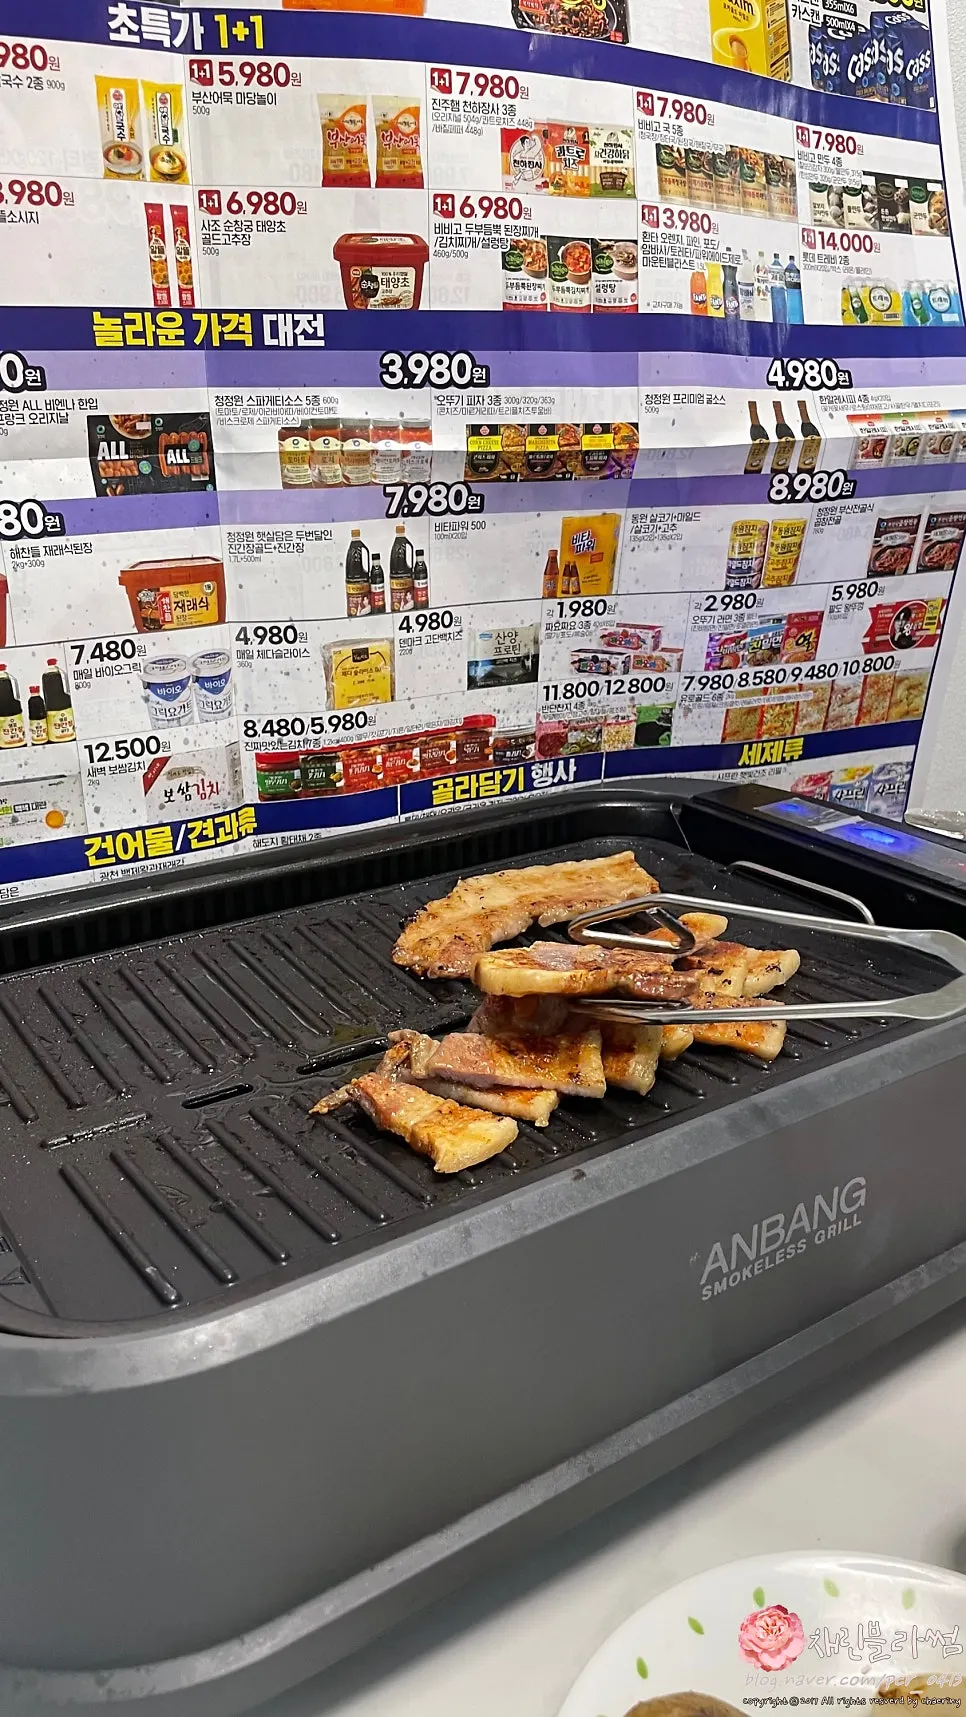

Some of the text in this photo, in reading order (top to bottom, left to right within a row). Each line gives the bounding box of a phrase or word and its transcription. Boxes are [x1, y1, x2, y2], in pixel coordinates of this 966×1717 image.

[792, 4, 820, 25] 카스캔
[108, 2, 264, 50] 초특가 1+1
[193, 62, 212, 80] 1+1
[26, 77, 66, 92] 2종 900g
[432, 71, 450, 87] 1+1
[192, 92, 277, 106] 부산어묵 마당놀이
[192, 106, 210, 116] 500g
[432, 99, 516, 116] 진주햄 천하장사 3종
[638, 119, 661, 132] 비비고
[662, 122, 671, 134] 국
[200, 191, 308, 216] 1+1 6,980원
[435, 195, 532, 220] 1+1 6,980원
[201, 220, 286, 234] 사조 순창궁 태양초
[434, 223, 539, 238] 비비고 두부듬뿍 된장찌개
[201, 233, 251, 247] 골드고추장
[642, 231, 658, 243] 환타
[203, 247, 220, 257] 500g
[433, 250, 469, 259] 460g/500g
[381, 277, 410, 289] 태양초
[92, 311, 325, 347] 놀라운 가격 대전
[22, 398, 98, 411] ALL 비엔나 한입
[215, 395, 339, 407] 청정원 스파게티소스 5종 600g
[436, 395, 465, 406] 오뚜기
[467, 395, 485, 406] 피자
[487, 395, 502, 406] 3종
[645, 394, 725, 405] 청정원 프리미엄 굴소스
[645, 406, 659, 414] 500g
[29, 412, 69, 425] 오리지날
[97, 441, 129, 461] ALL
[166, 449, 190, 464] ALL
[632, 513, 648, 524] 동원
[434, 520, 486, 532] 비타파워 500
[227, 530, 332, 543] 청정원 햇살담은 두번달인
[571, 530, 591, 545] 비타
[10, 542, 93, 559] 해찬들 재래식된장
[574, 539, 596, 555] 파워
[11, 559, 45, 569] 2kg+300g
[173, 597, 210, 612] 재래식
[578, 621, 591, 630] 3종
[692, 615, 715, 625] 오뚜기
[424, 631, 463, 646] 고단백치즈
[495, 630, 519, 645] 산양
[236, 649, 310, 660] 매일 체다슬라이스
[493, 644, 520, 656] 프로틴
[73, 662, 142, 680] 매일 바이오그릭
[75, 681, 91, 690] 800g
[157, 685, 182, 696] 바이오
[204, 679, 226, 689] 바이오
[738, 738, 803, 766] 세제류
[87, 760, 146, 778] 새벽 보쌈김치
[432, 768, 525, 806] 골라담기
[531, 759, 576, 788] 행사
[84, 806, 258, 866] 건어물/견과류
[0, 887, 19, 899] 담은
[700, 1176, 867, 1285] ANBANG
[702, 1213, 862, 1301] SMOKELESS GRILL
